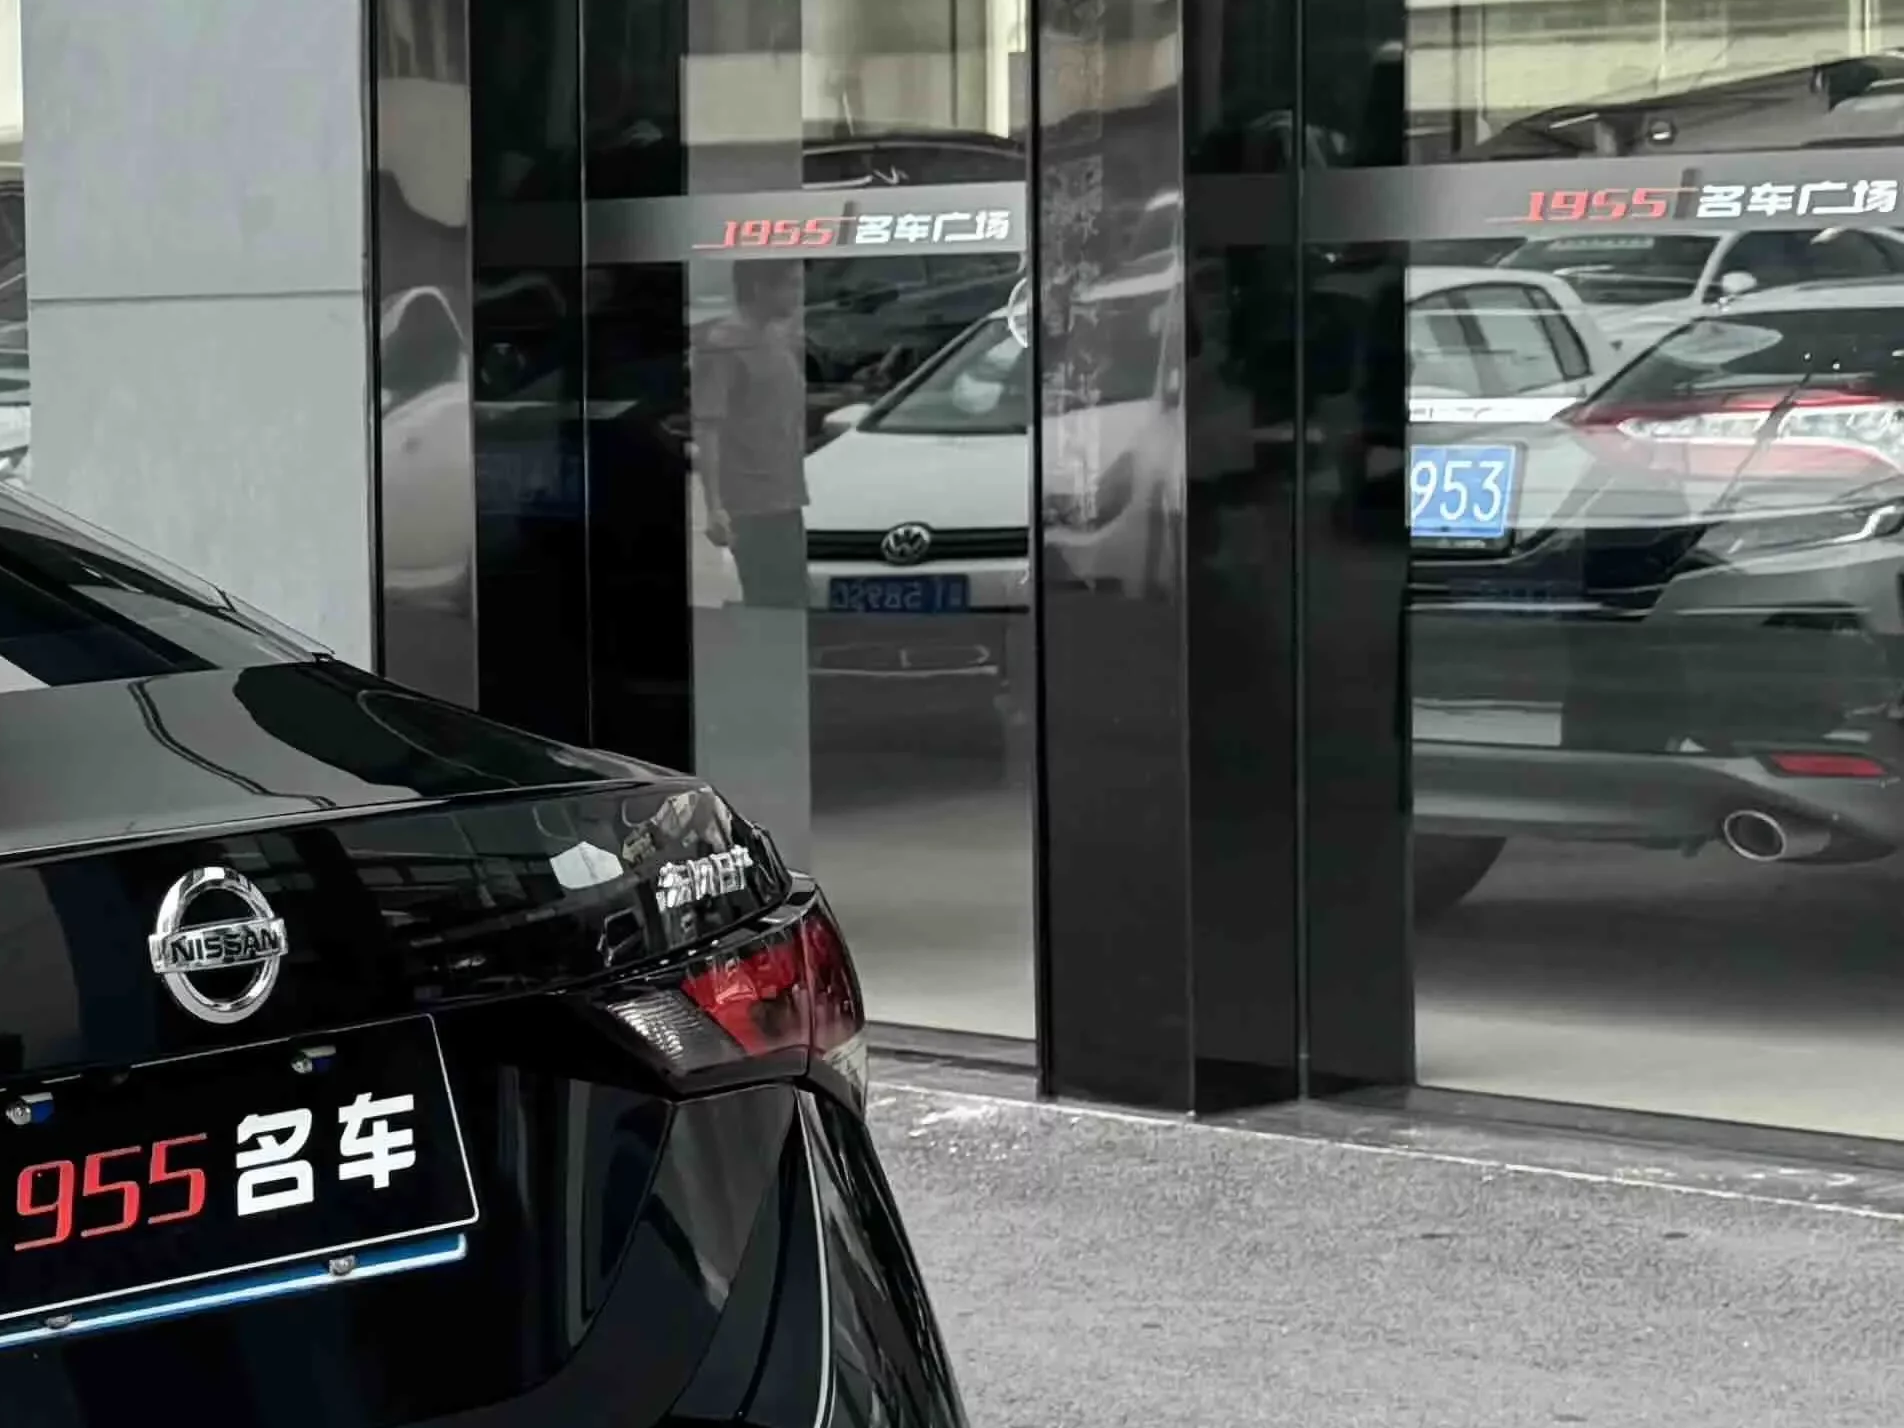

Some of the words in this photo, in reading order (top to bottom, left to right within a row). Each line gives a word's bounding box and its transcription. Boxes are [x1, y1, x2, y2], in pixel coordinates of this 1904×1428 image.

[1525, 186, 1668, 223] 1955
[1696, 179, 1899, 218] 名车广场
[721, 217, 838, 248] 1955
[854, 209, 1012, 244] 名车广场
[170, 926, 279, 964] NISSAN
[235, 1091, 417, 1217] 名车
